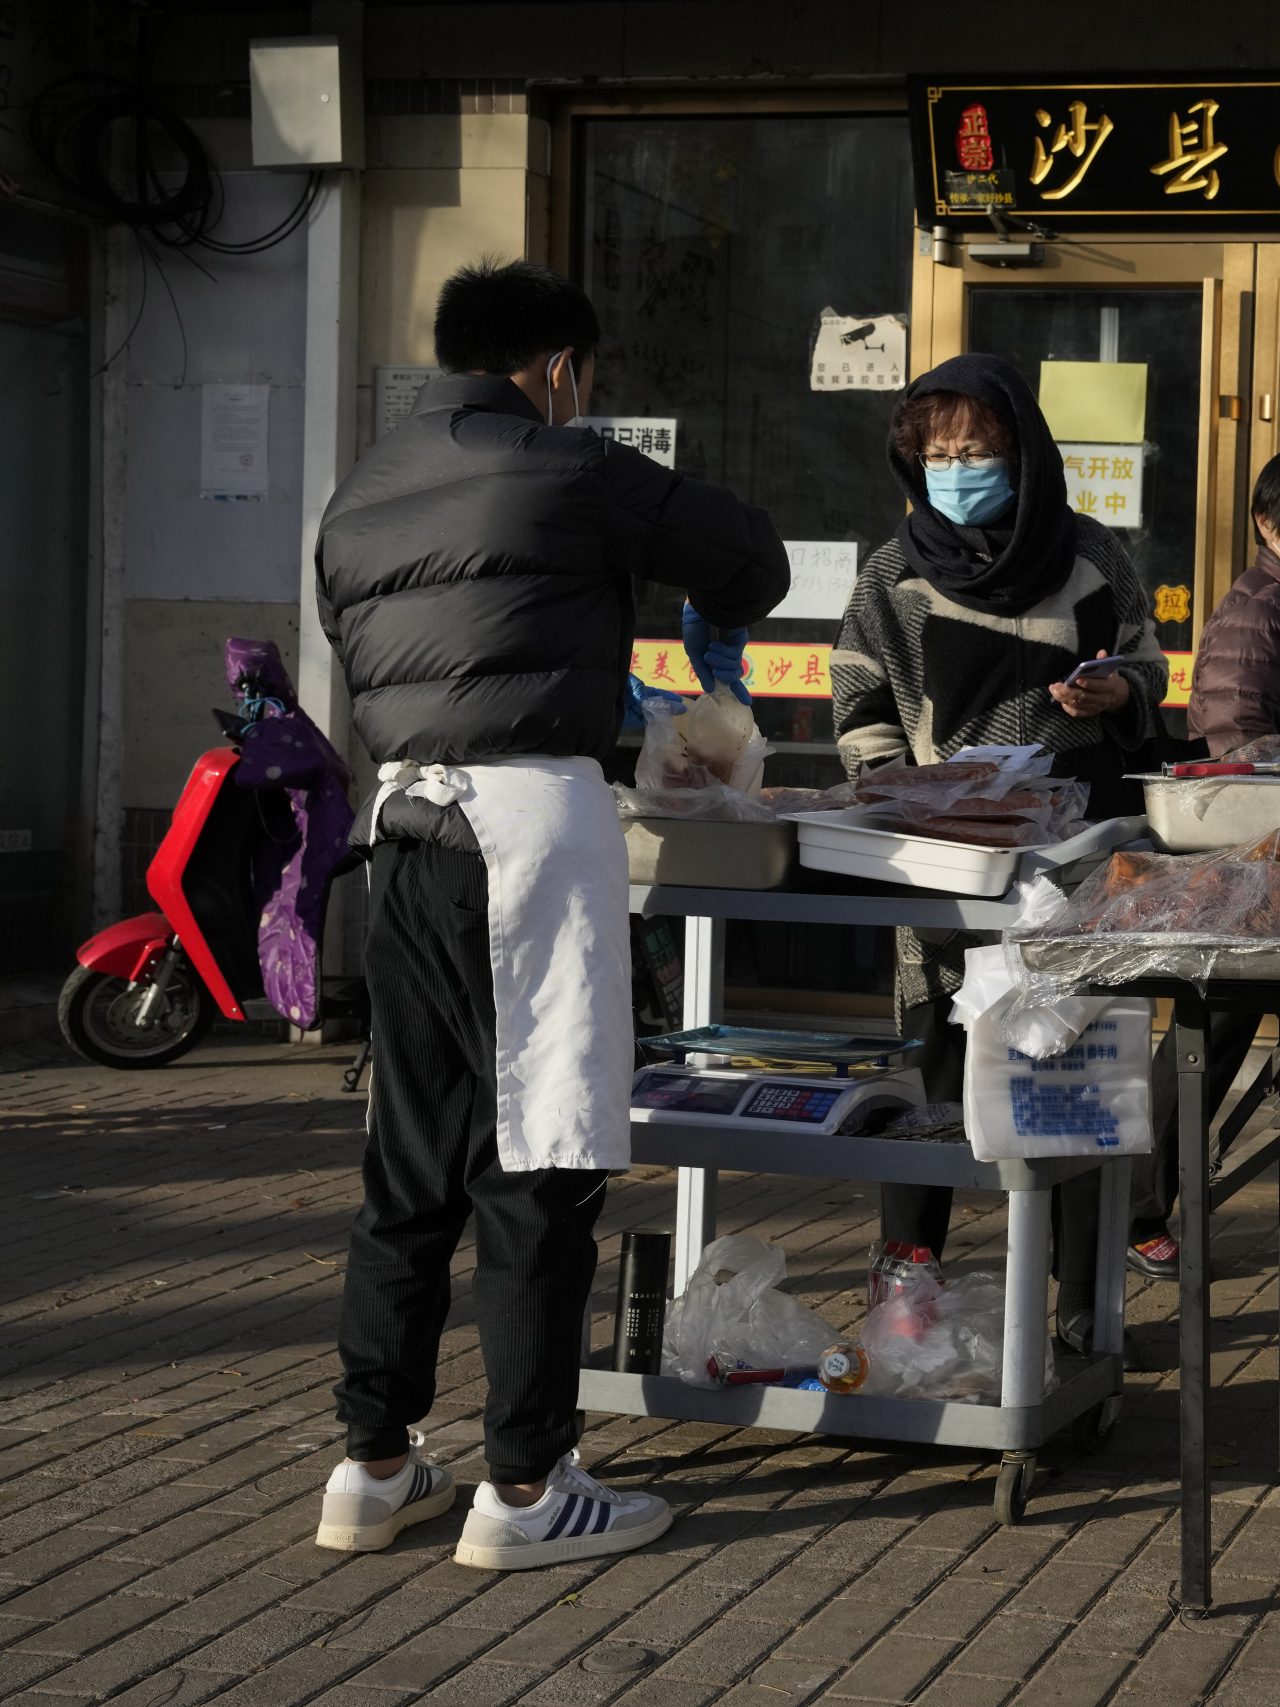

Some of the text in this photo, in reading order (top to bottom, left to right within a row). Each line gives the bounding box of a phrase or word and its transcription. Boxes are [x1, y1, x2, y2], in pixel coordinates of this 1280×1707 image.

[961, 106, 989, 168] 正宗
[1064, 456, 1134, 480] 气开放
[1075, 491, 1127, 514] 业中
[1163, 592, 1181, 608] 拉
[767, 654, 826, 686] 沙县
